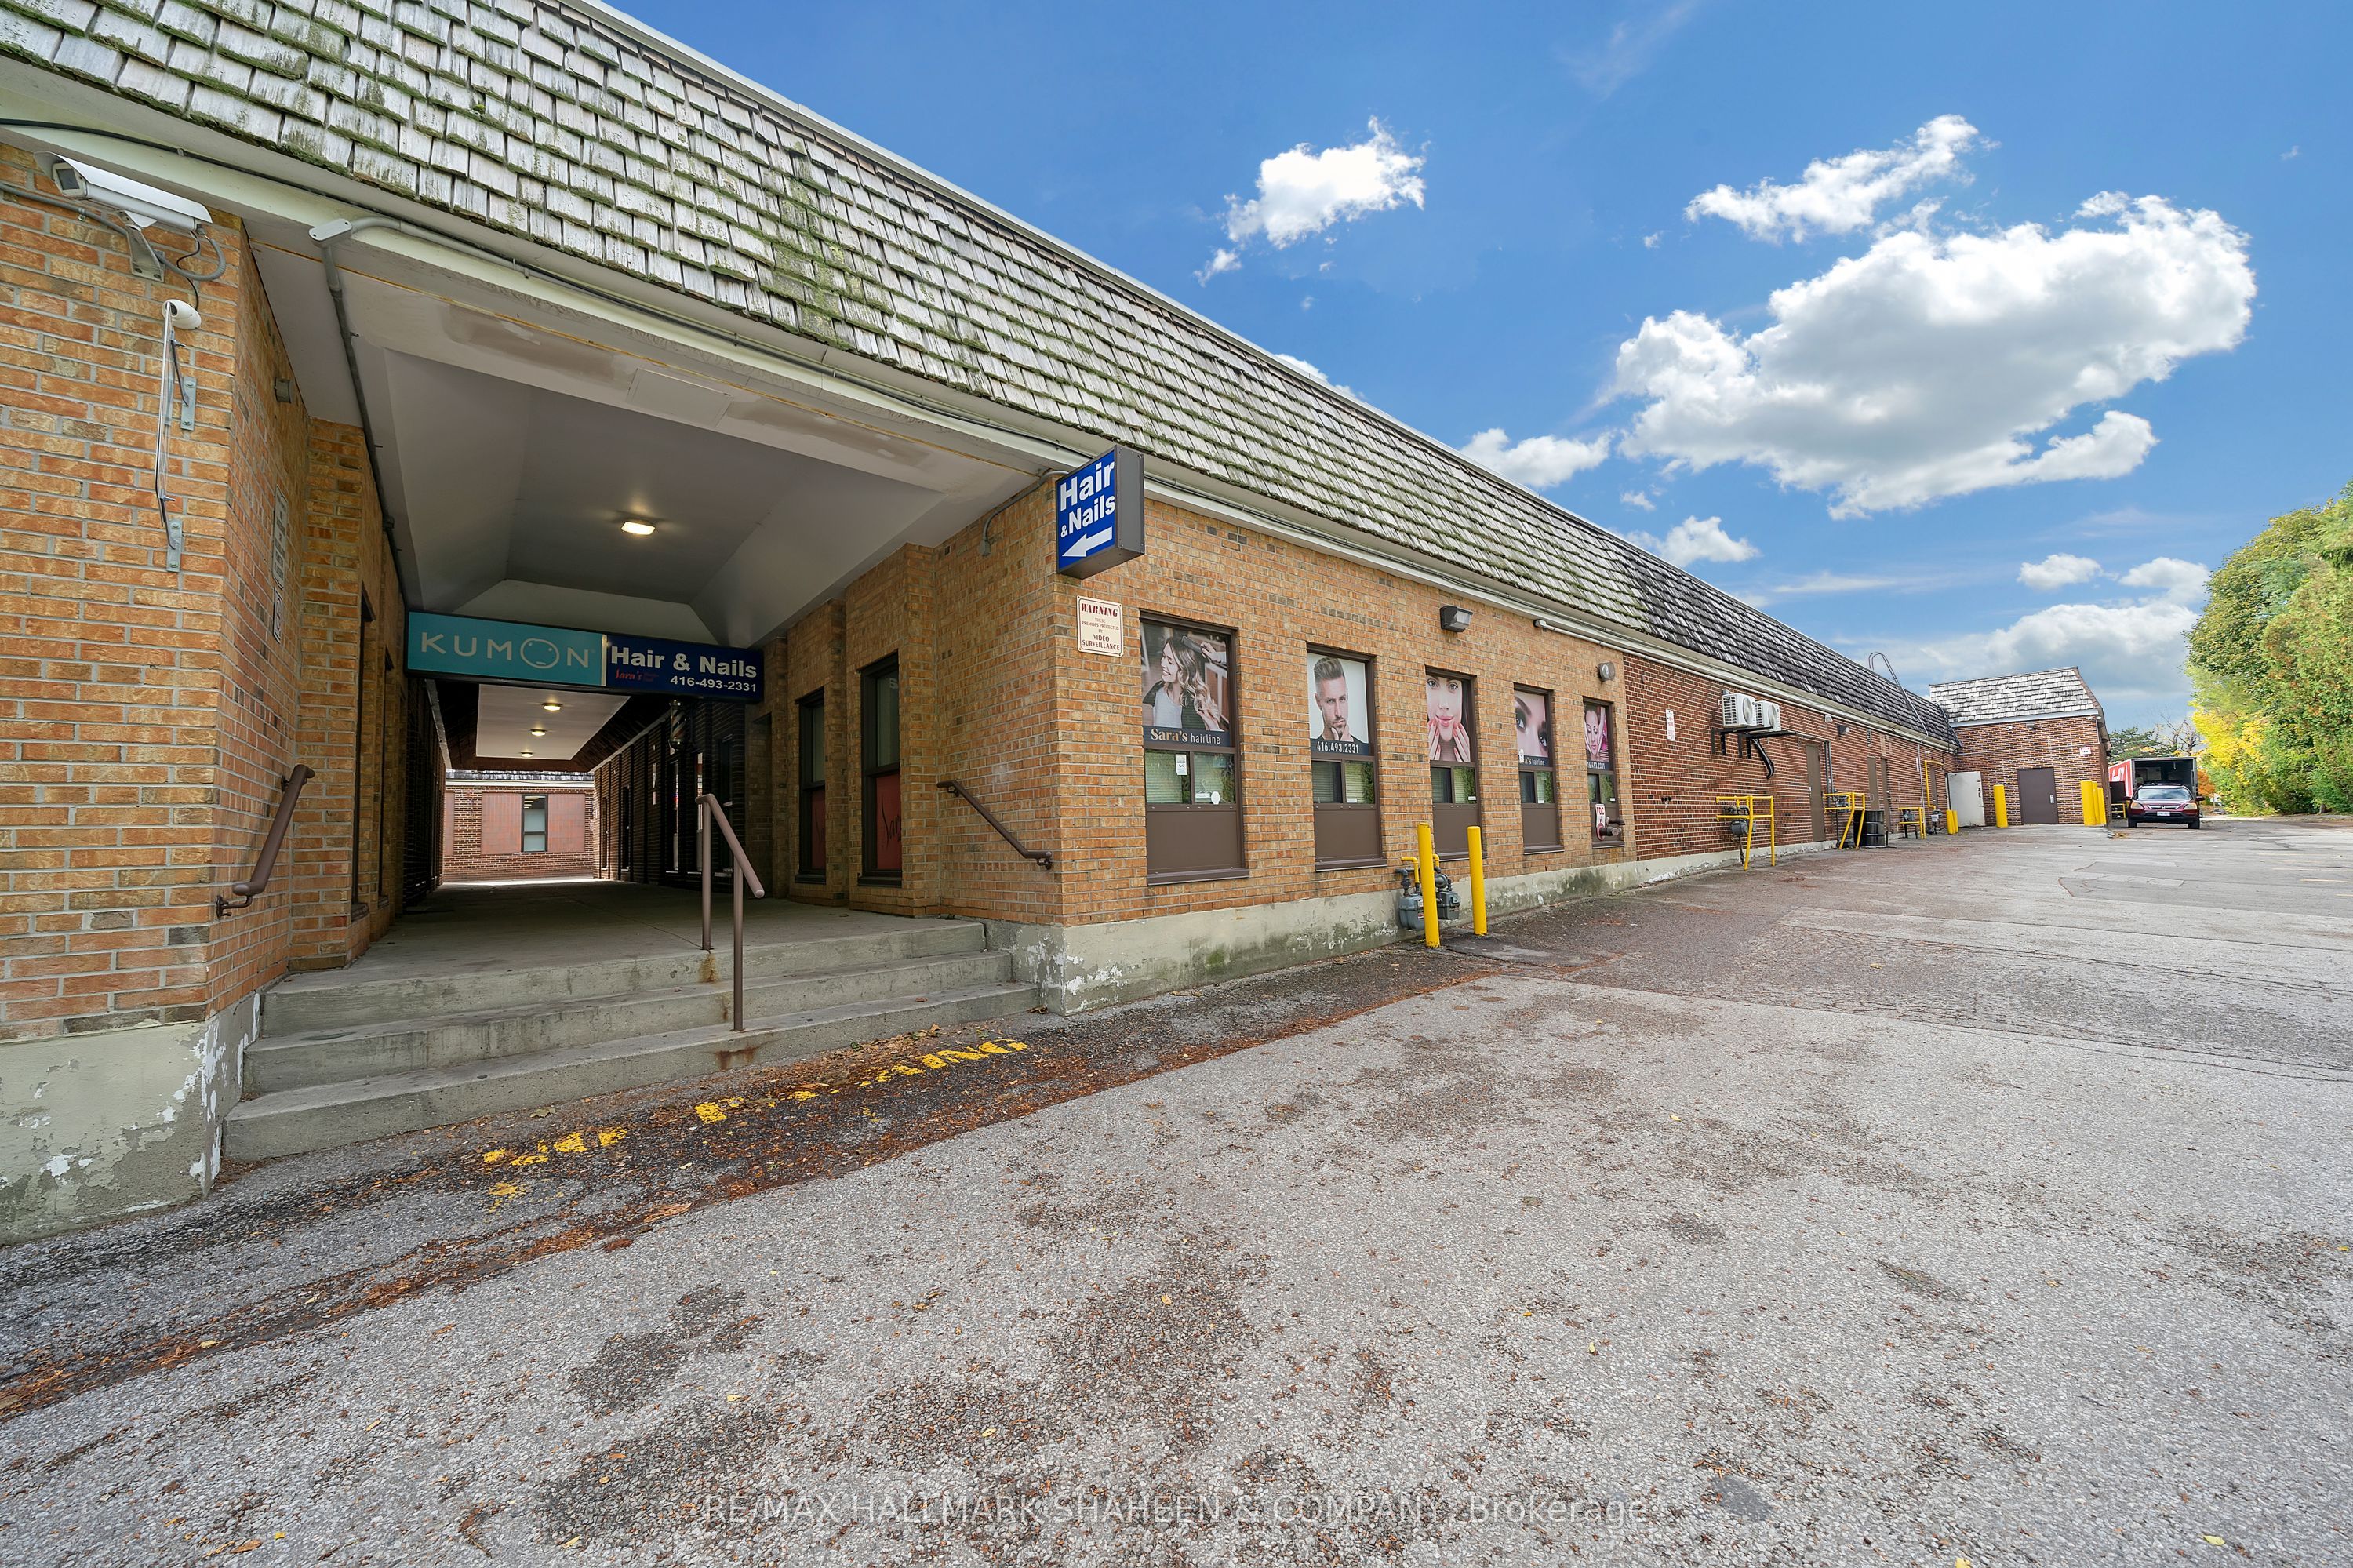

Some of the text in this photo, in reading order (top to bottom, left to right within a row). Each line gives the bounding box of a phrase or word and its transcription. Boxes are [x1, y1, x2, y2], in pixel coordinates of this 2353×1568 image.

[1060, 462, 1115, 511] Hair
[1081, 603, 1118, 617] WARNING
[1082, 639, 1120, 651] SURVEILLANCE
[1093, 634, 1110, 642] VIDEO
[421, 632, 589, 669] KUMON
[611, 646, 758, 678] Hair & Nails
[670, 675, 757, 693] 416-493-2331
[1151, 728, 1220, 744] Sara's hairline
[1317, 741, 1358, 753] 416.493.2331
